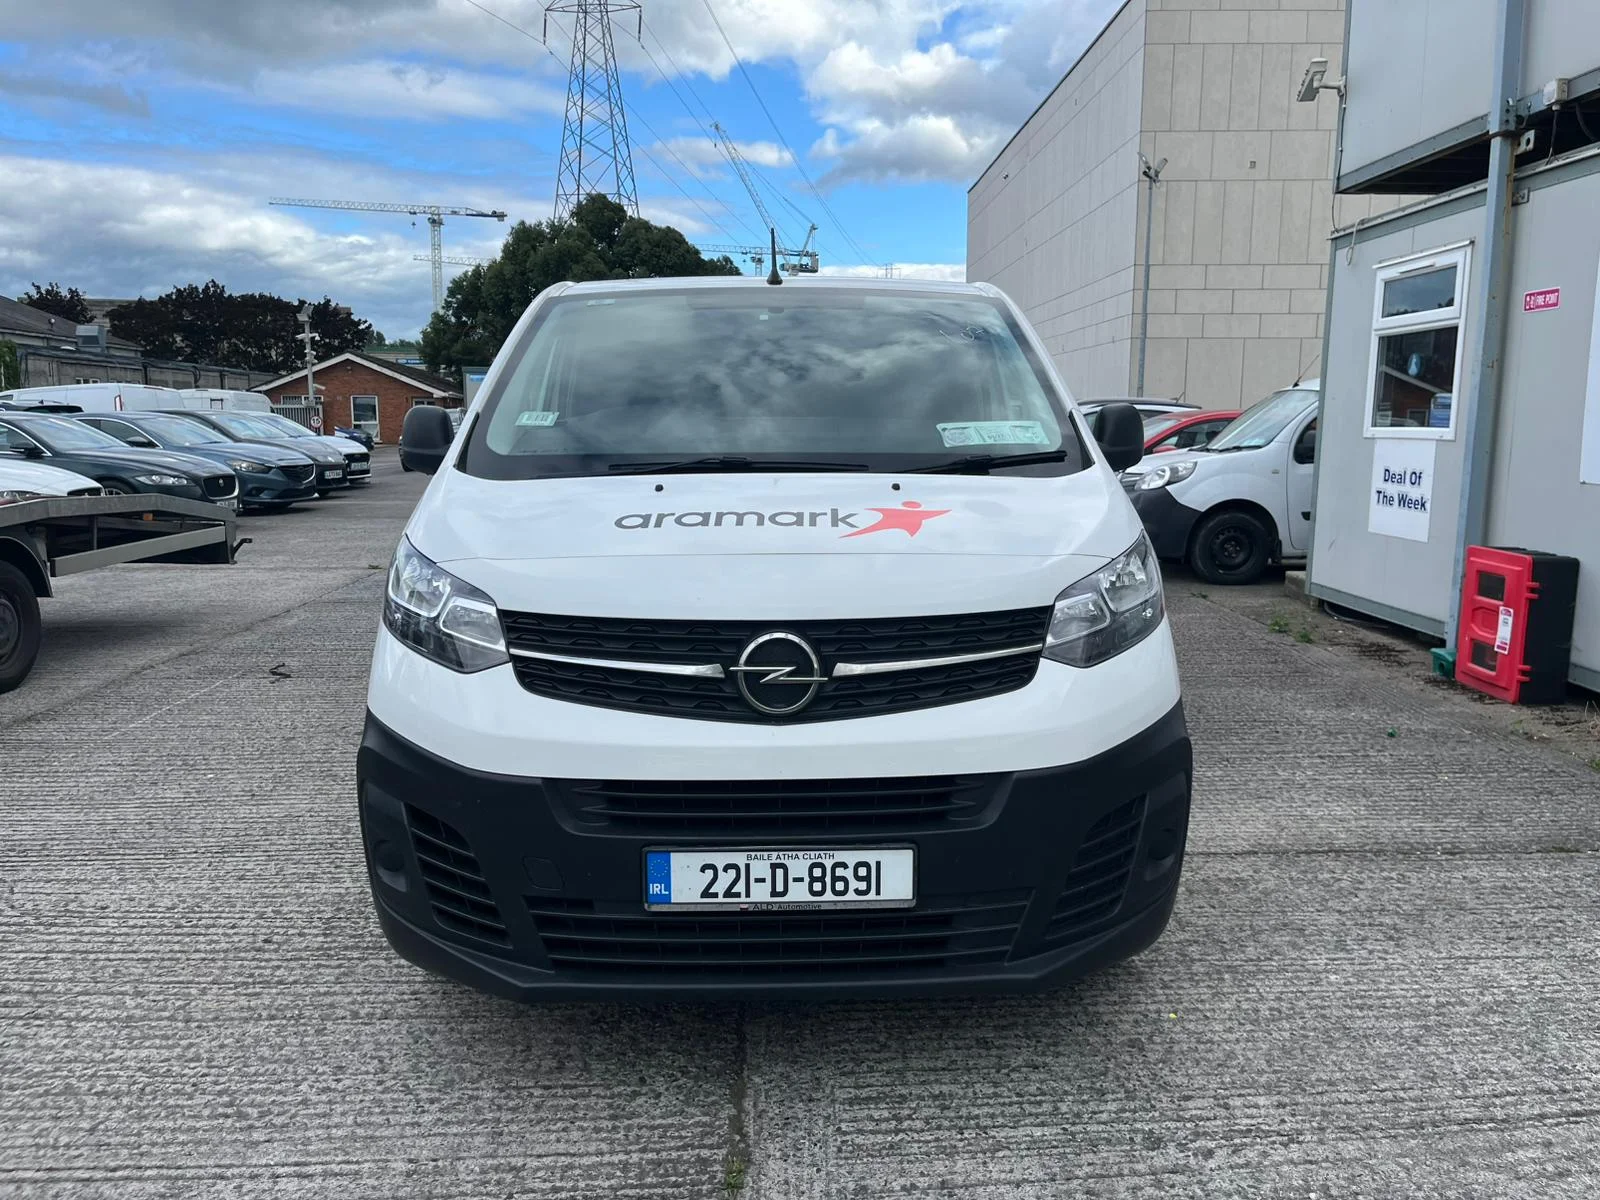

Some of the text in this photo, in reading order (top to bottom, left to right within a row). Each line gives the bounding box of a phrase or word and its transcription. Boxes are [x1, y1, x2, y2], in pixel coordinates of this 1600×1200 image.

[1384, 469, 1423, 486] Deal Of
[1376, 490, 1427, 512] The Week
[614, 508, 860, 530] aramark
[746, 853, 773, 861] BAILE
[802, 852, 835, 861] CLIATH
[649, 883, 669, 895] IRL
[699, 860, 882, 899] 221-D-8691
